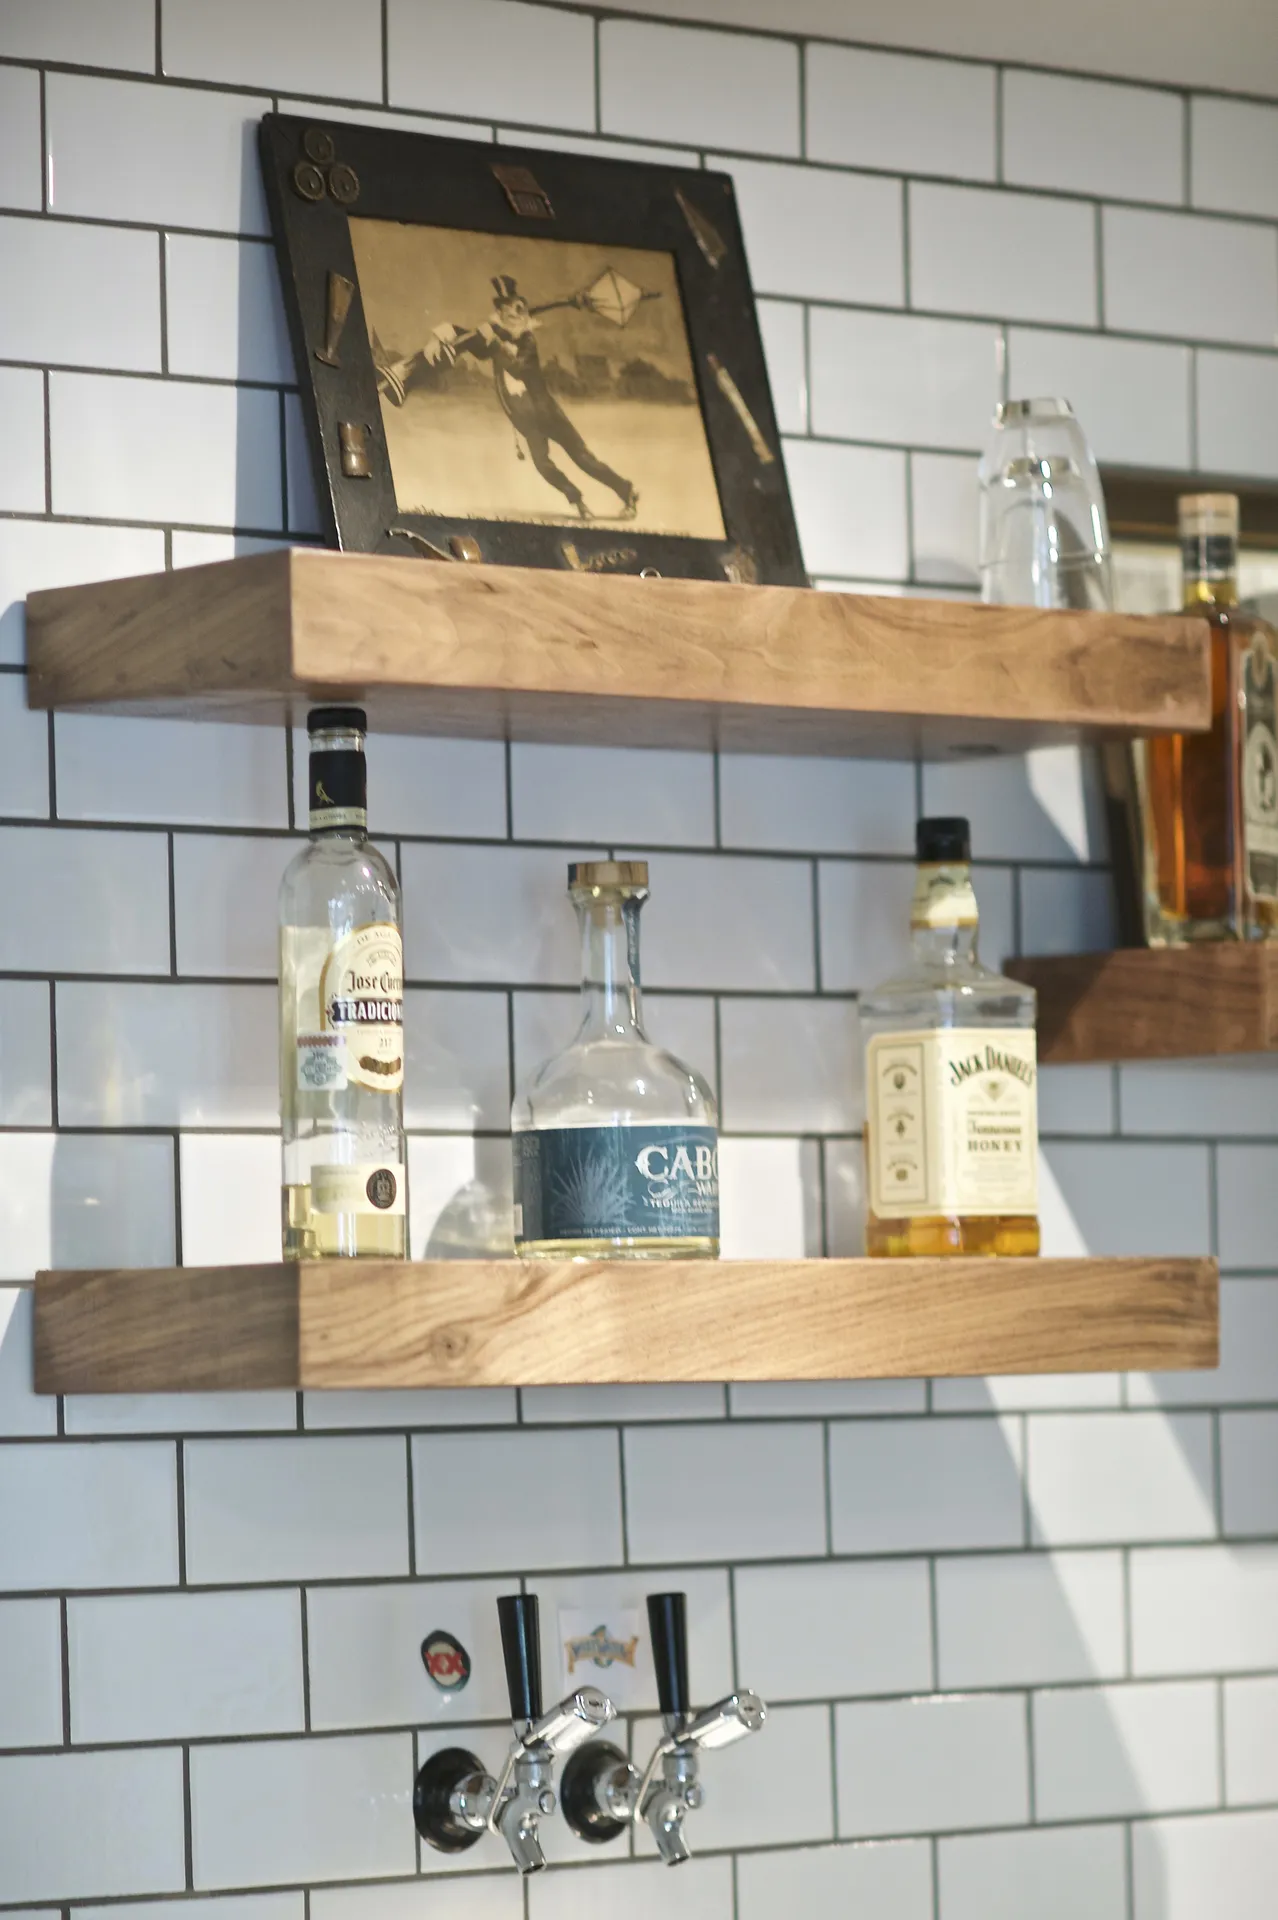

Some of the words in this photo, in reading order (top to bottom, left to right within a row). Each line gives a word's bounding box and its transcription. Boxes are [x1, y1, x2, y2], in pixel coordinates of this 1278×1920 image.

[346, 970, 378, 993] Jose
[948, 1053, 983, 1087] JACK
[967, 1139, 1022, 1152] HONEY
